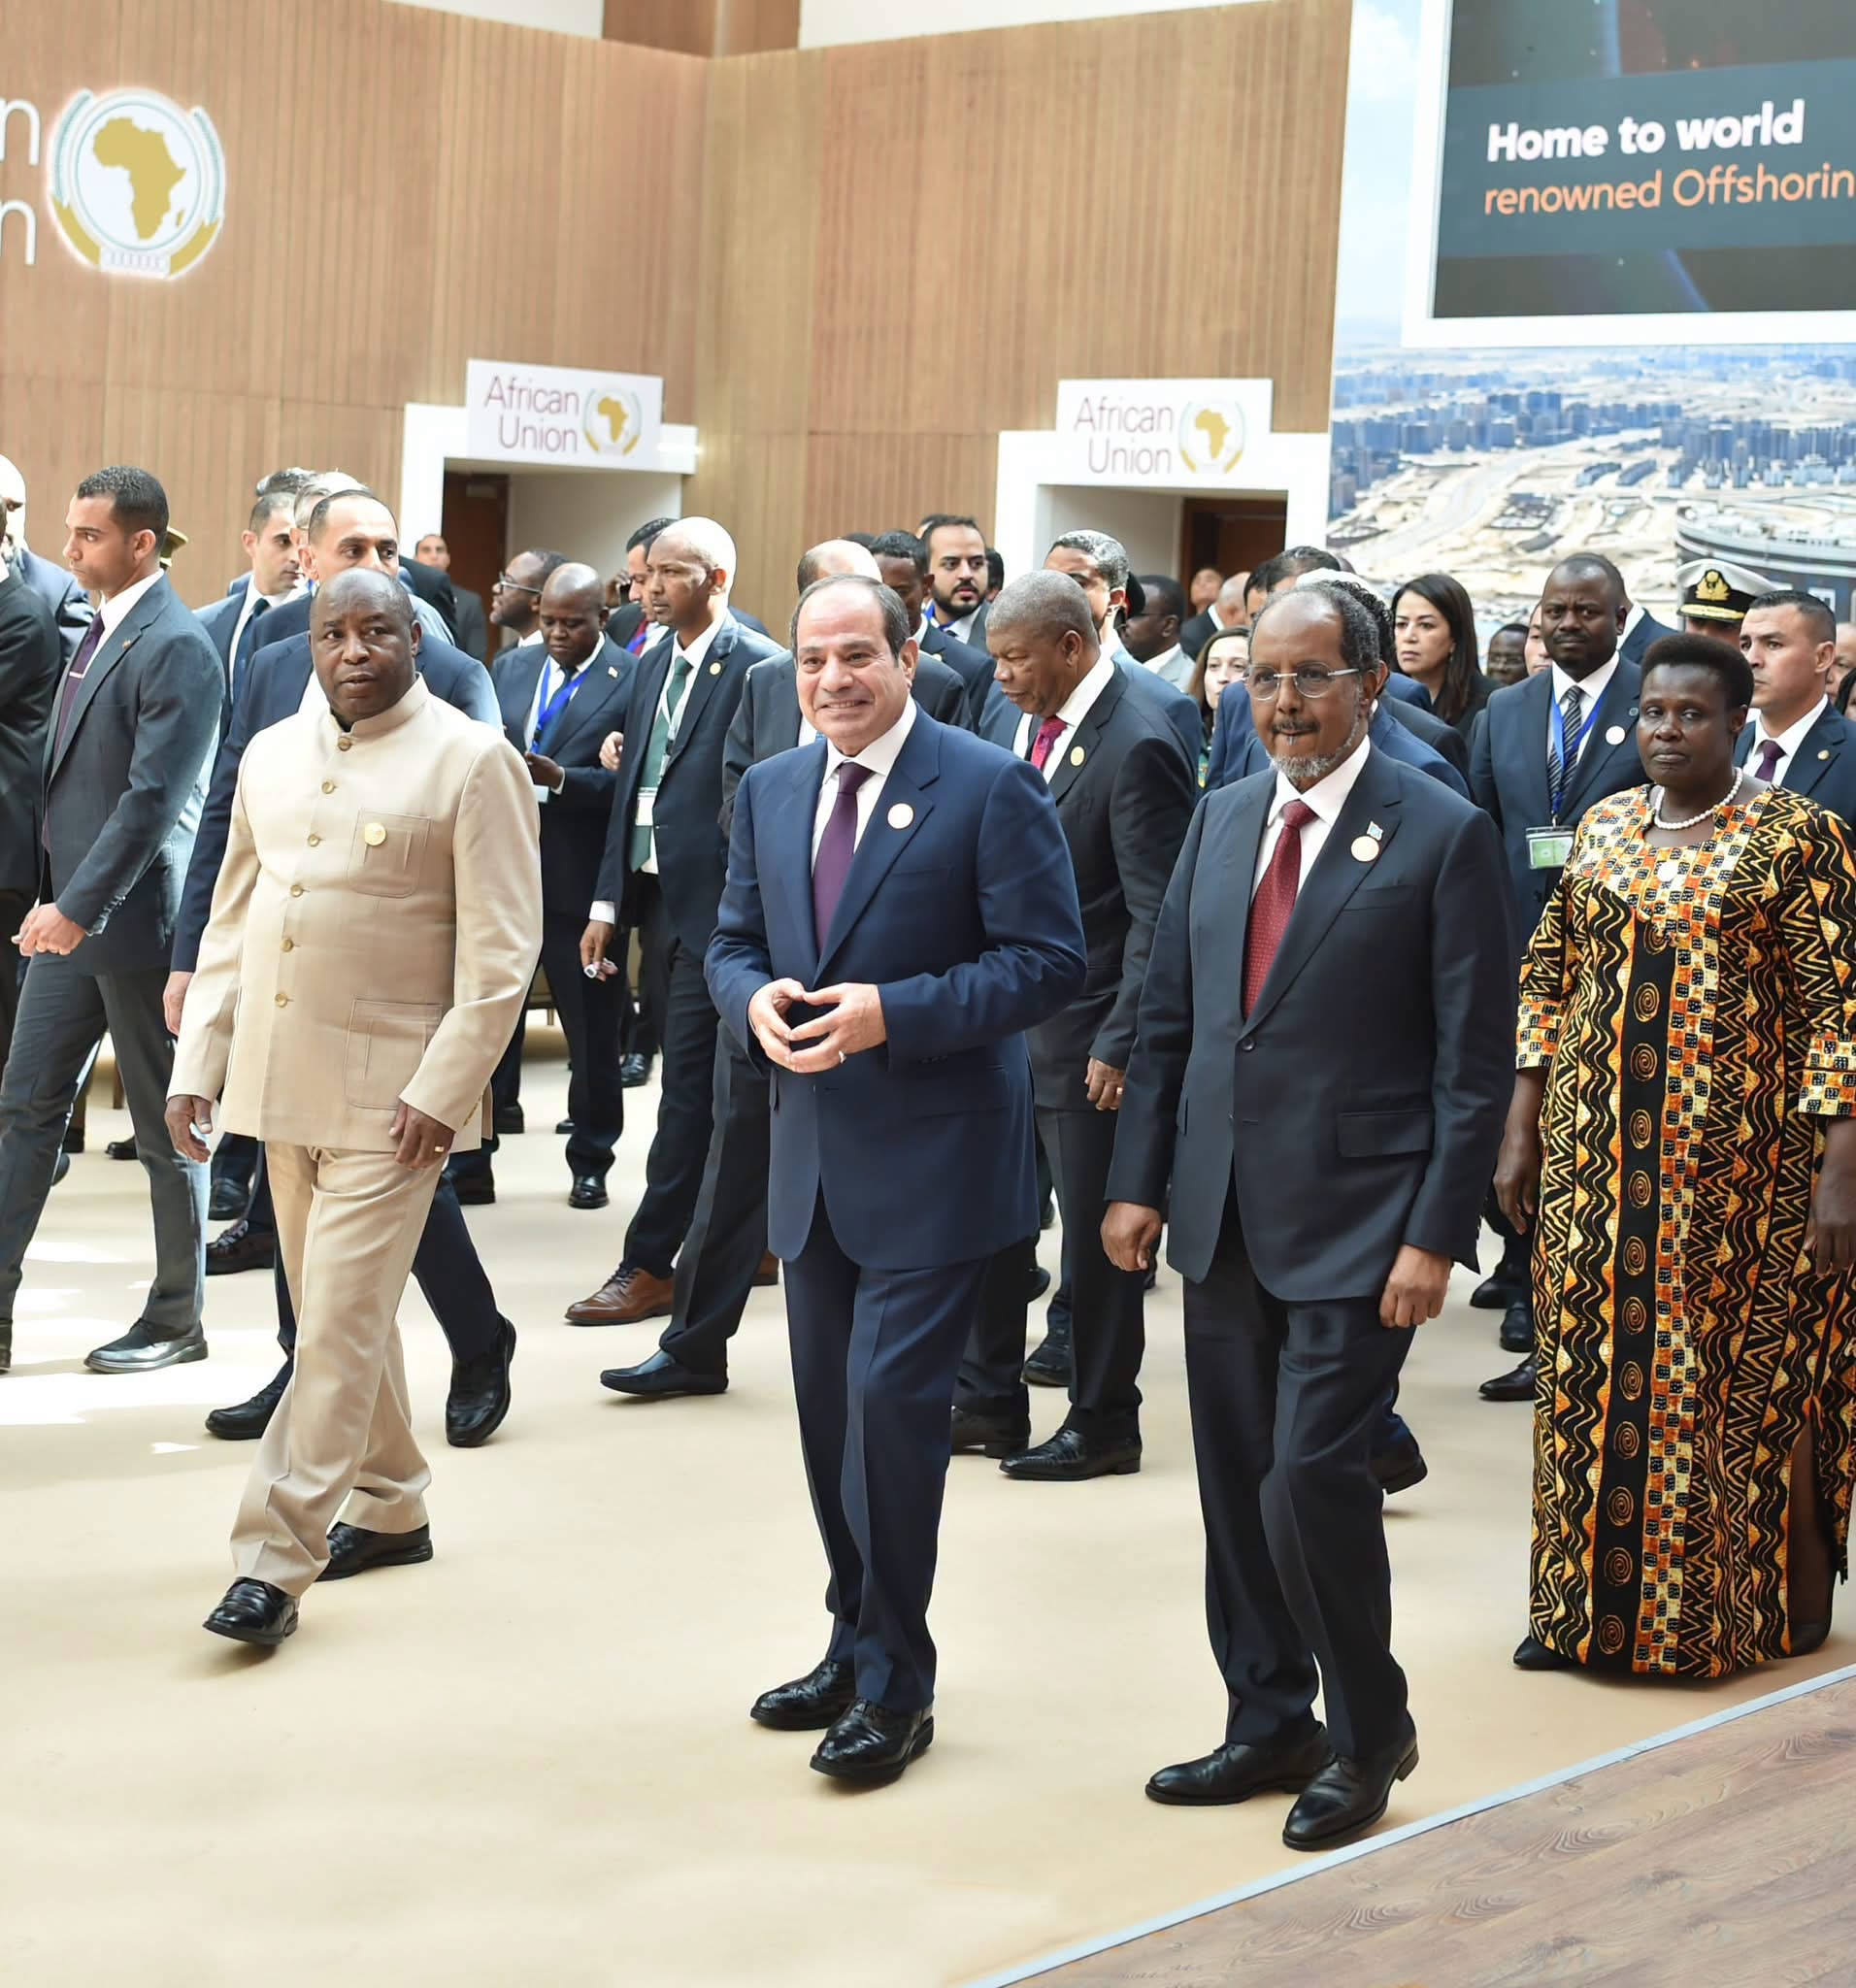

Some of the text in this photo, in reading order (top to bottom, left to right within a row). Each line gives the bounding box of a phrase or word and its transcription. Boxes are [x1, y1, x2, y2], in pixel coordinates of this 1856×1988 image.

[1487, 98, 1806, 162] Home to world
[1484, 169, 1663, 215] renowned
[484, 376, 580, 415] African
[498, 415, 579, 453] Union
[1074, 396, 1174, 434] African
[1088, 437, 1172, 475] Union
